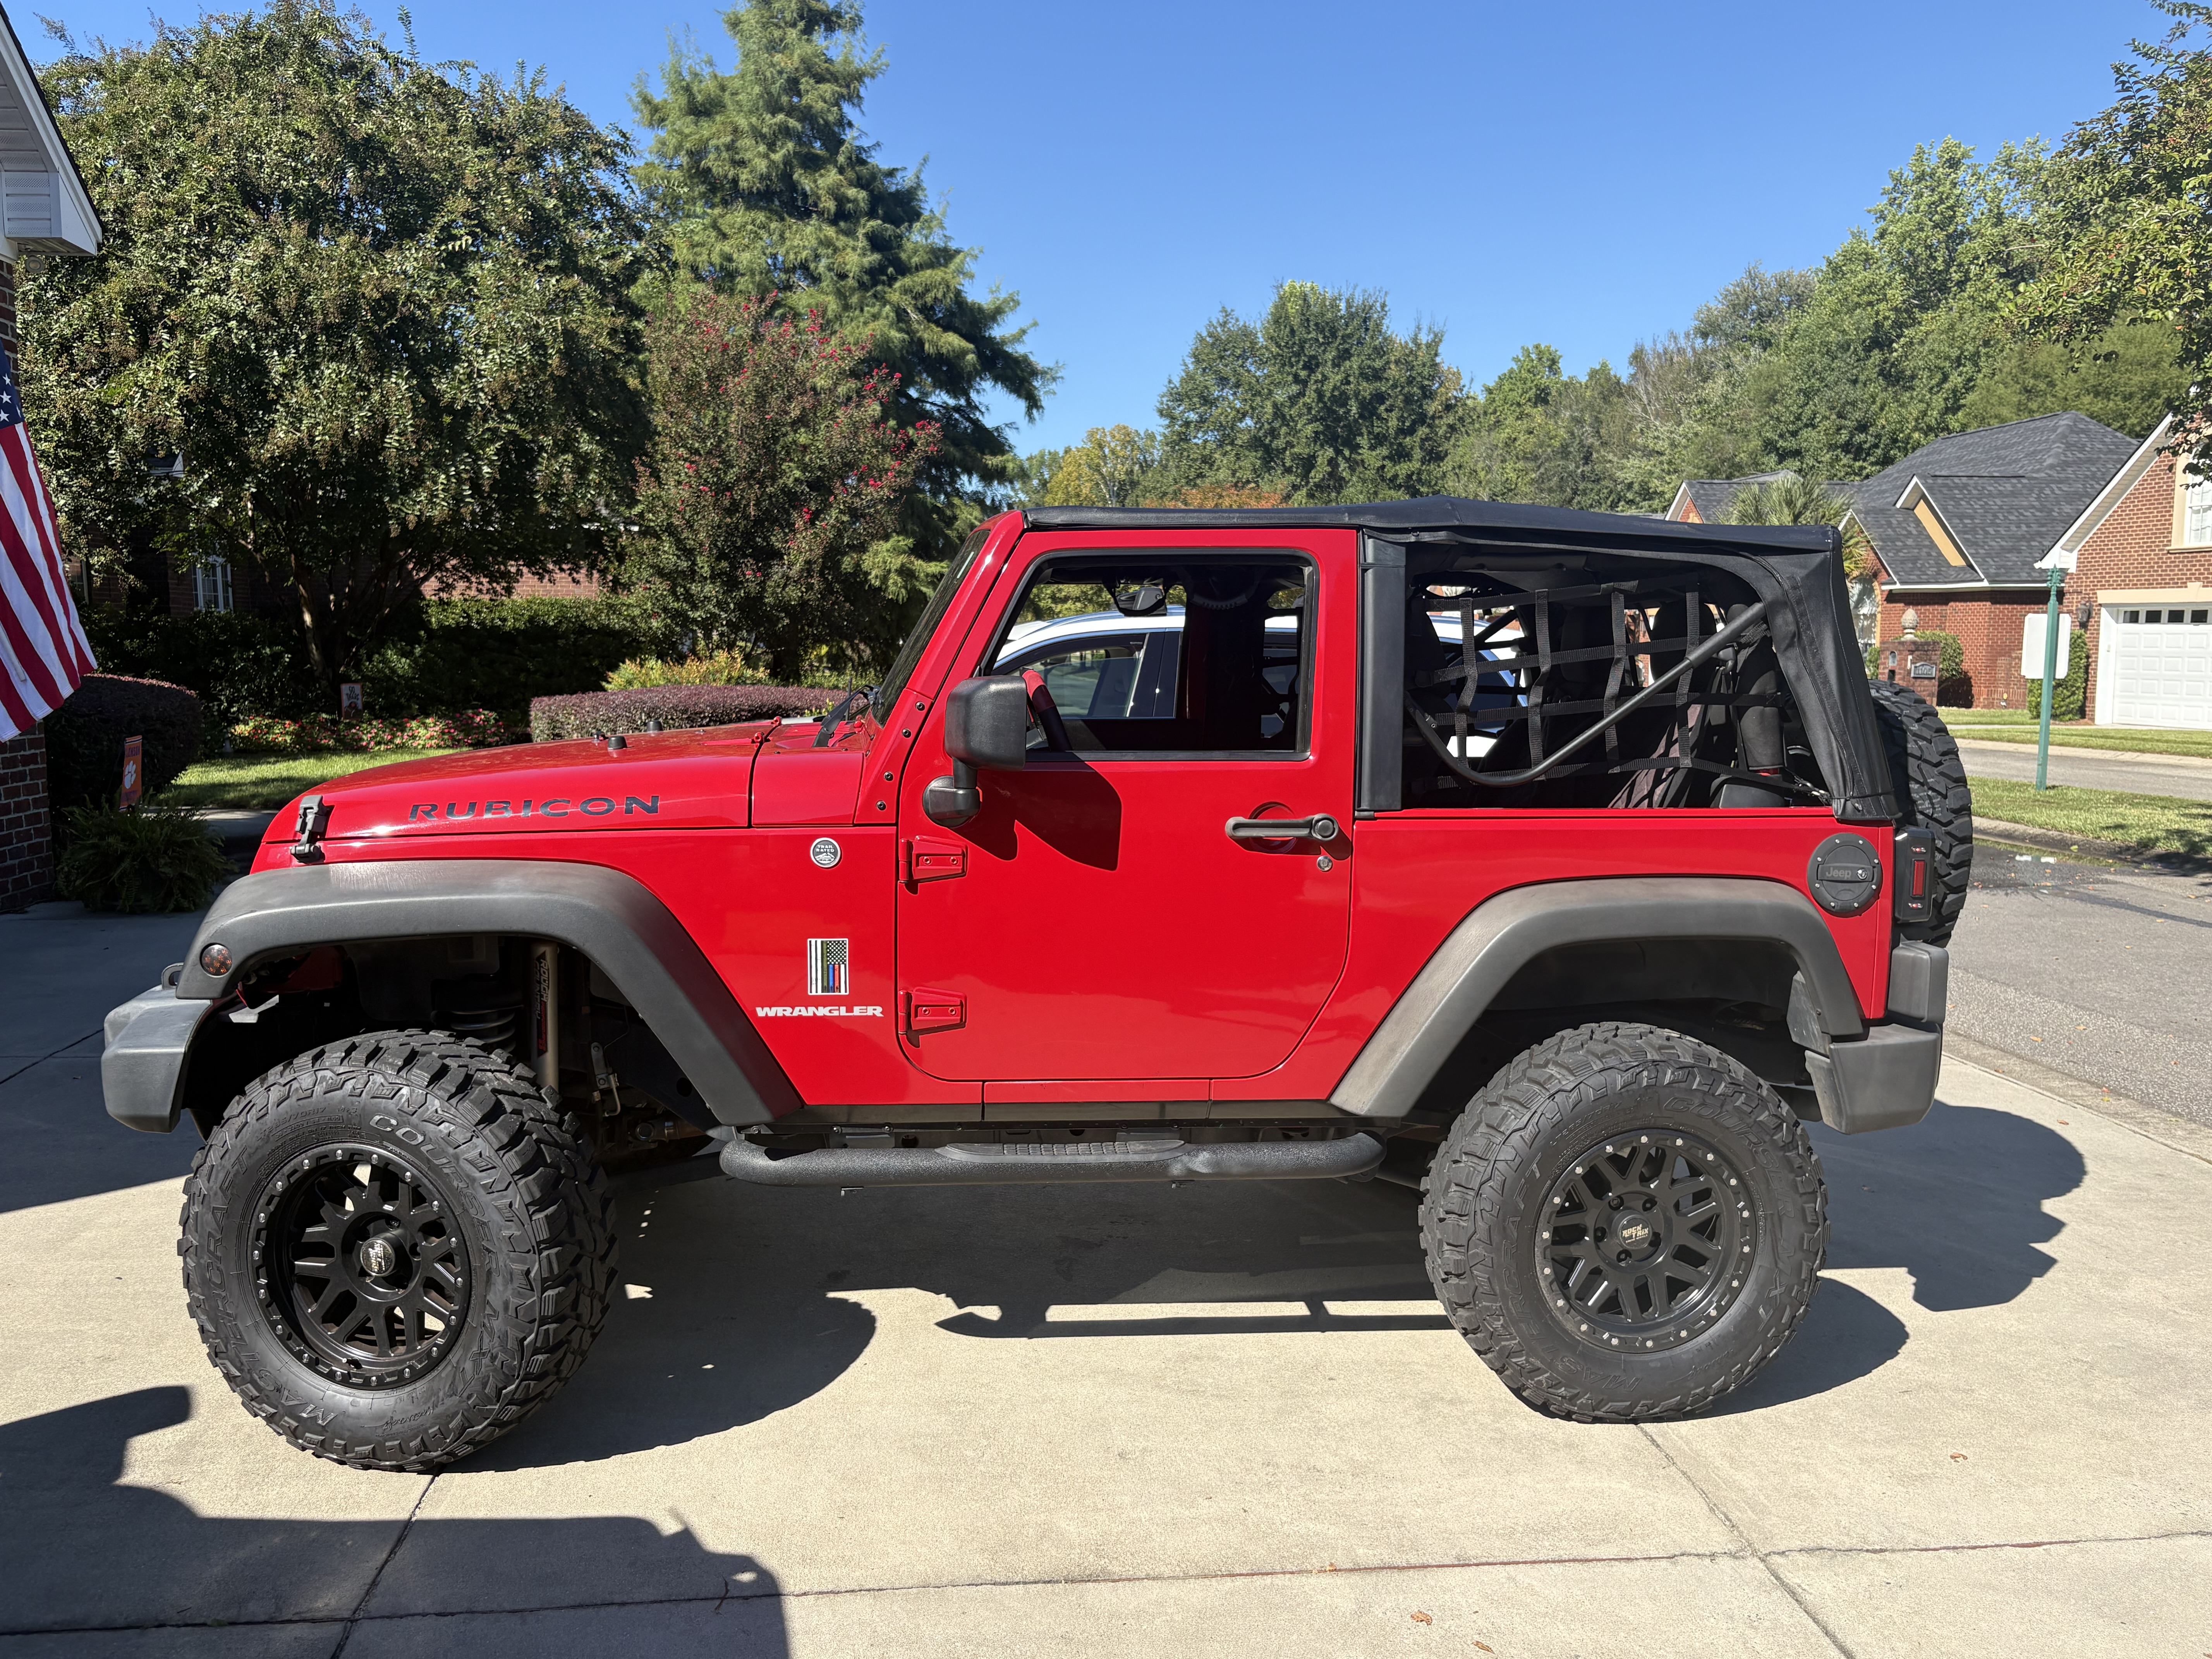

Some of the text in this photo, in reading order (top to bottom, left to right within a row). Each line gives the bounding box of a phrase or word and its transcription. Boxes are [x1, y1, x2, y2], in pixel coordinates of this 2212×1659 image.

[409, 795, 659, 821] RUBICON
[1826, 867, 1851, 880] Jeep
[540, 959, 549, 1002] ROUGH
[756, 1006, 884, 1017] WRANGLER
[257, 1107, 326, 1141] LT285/70R17
[1663, 1097, 1795, 1218] COURSER
[369, 1113, 500, 1277] COURSER
[1622, 1223, 1642, 1238] ROCK
[206, 1145, 338, 1426] MASTERCRAFT
[459, 1298, 499, 1397] MXT
